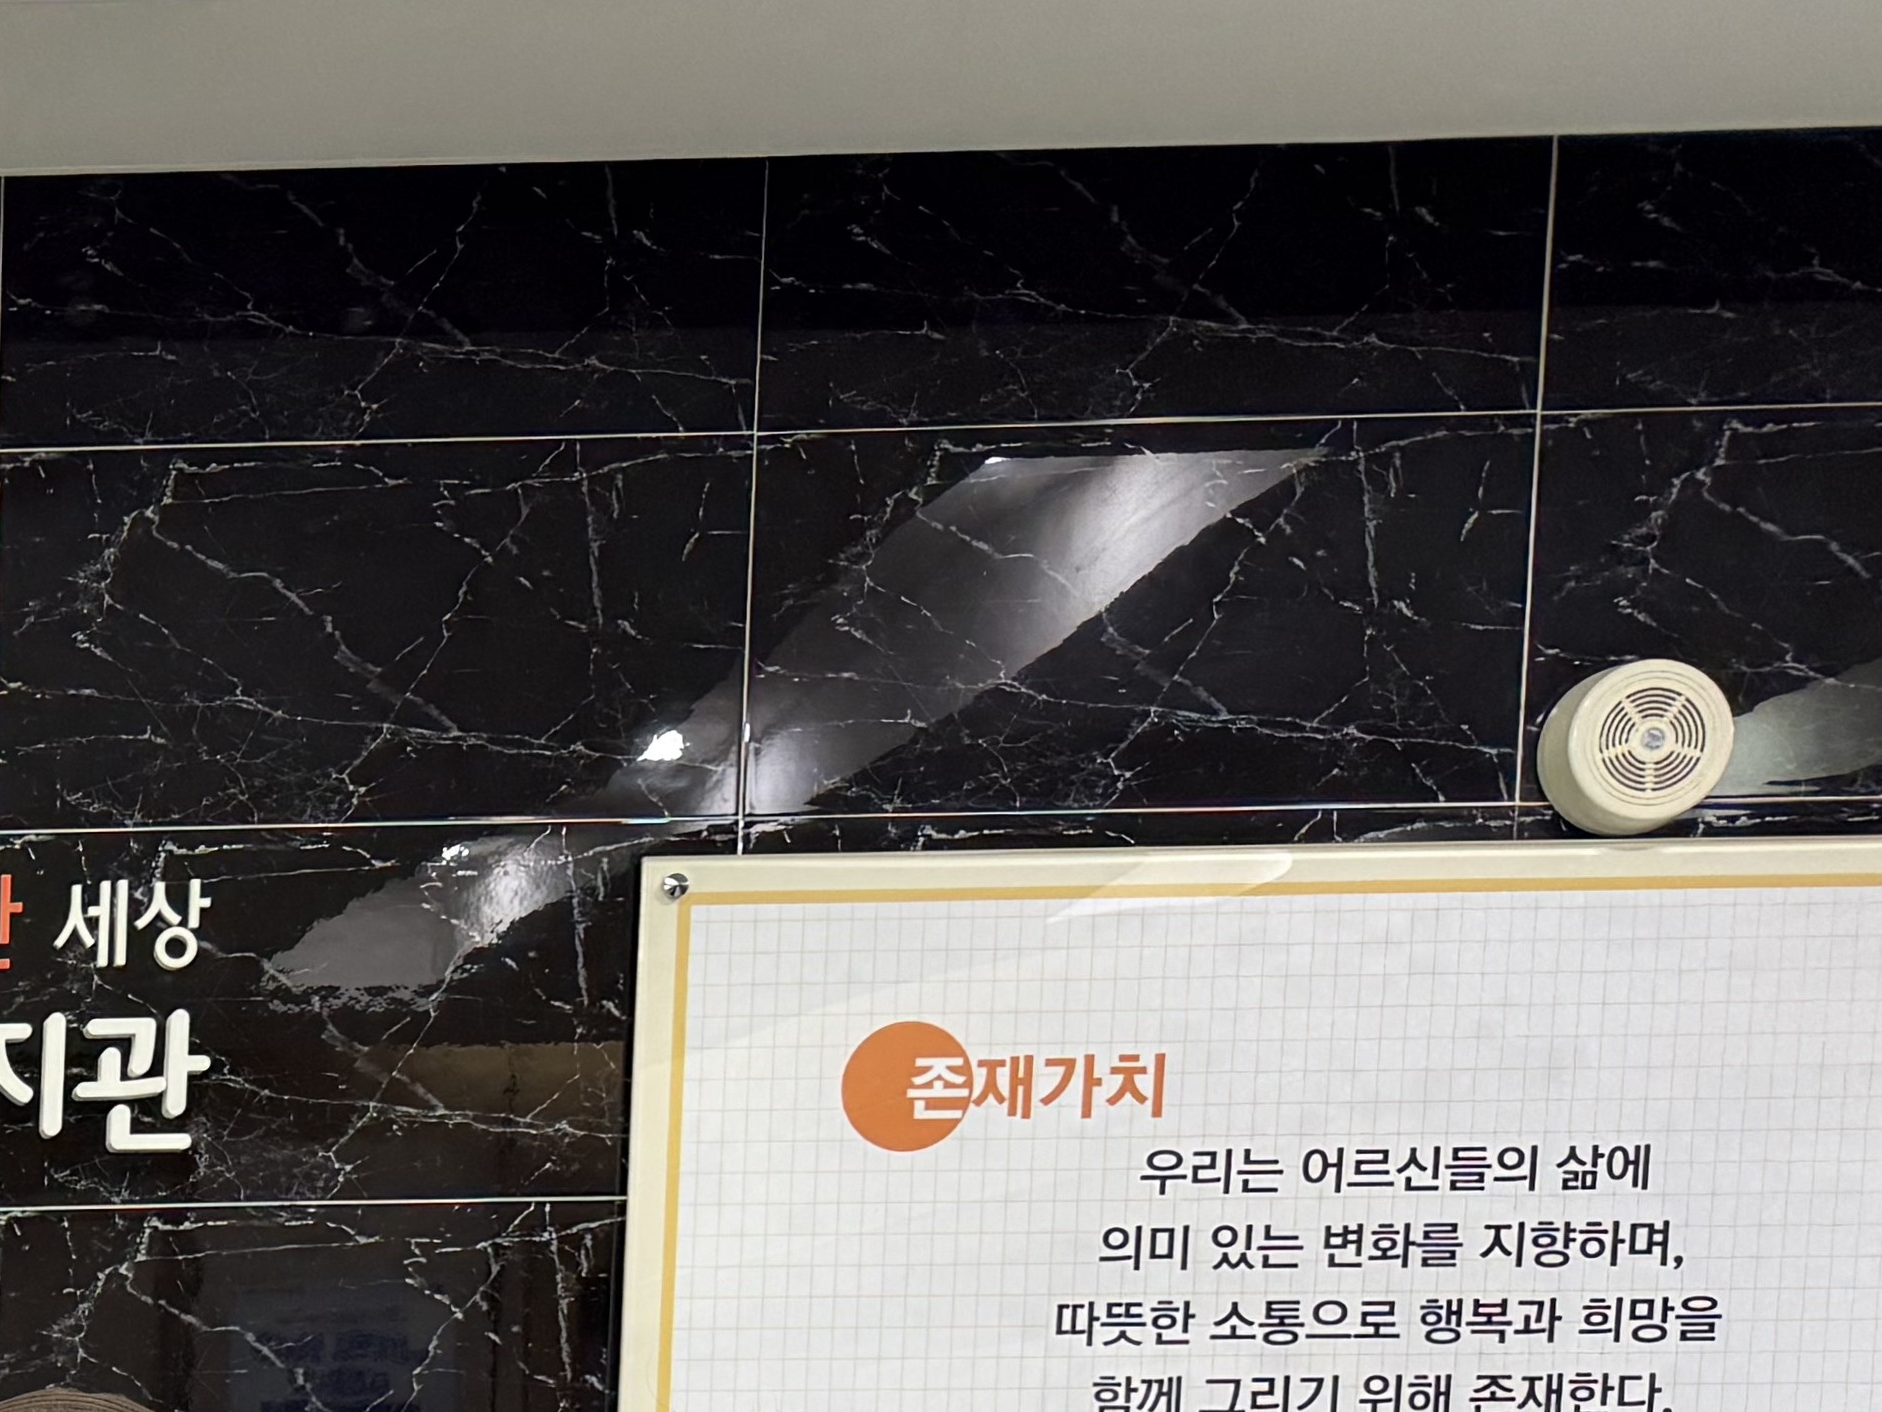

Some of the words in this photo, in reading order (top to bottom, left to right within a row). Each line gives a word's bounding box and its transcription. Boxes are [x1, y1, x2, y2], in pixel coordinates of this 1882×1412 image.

[54, 879, 211, 972] 세상
[906, 1054, 1167, 1121] 존재가치
[1140, 1148, 1284, 1196] 우리는
[1302, 1144, 1538, 1194] 어르신들의
[1556, 1143, 1651, 1191] 삶에
[1099, 1224, 1190, 1271] 의미
[1211, 1224, 1304, 1270] 있는
[1323, 1222, 1464, 1269] 변화를
[1479, 1219, 1684, 1270] 지향하며,
[1055, 1300, 1196, 1347] 따뜻한
[1209, 1300, 1401, 1346] 소통으로
[1419, 1297, 1563, 1345] 행복과
[1578, 1295, 1723, 1343] 희망을
